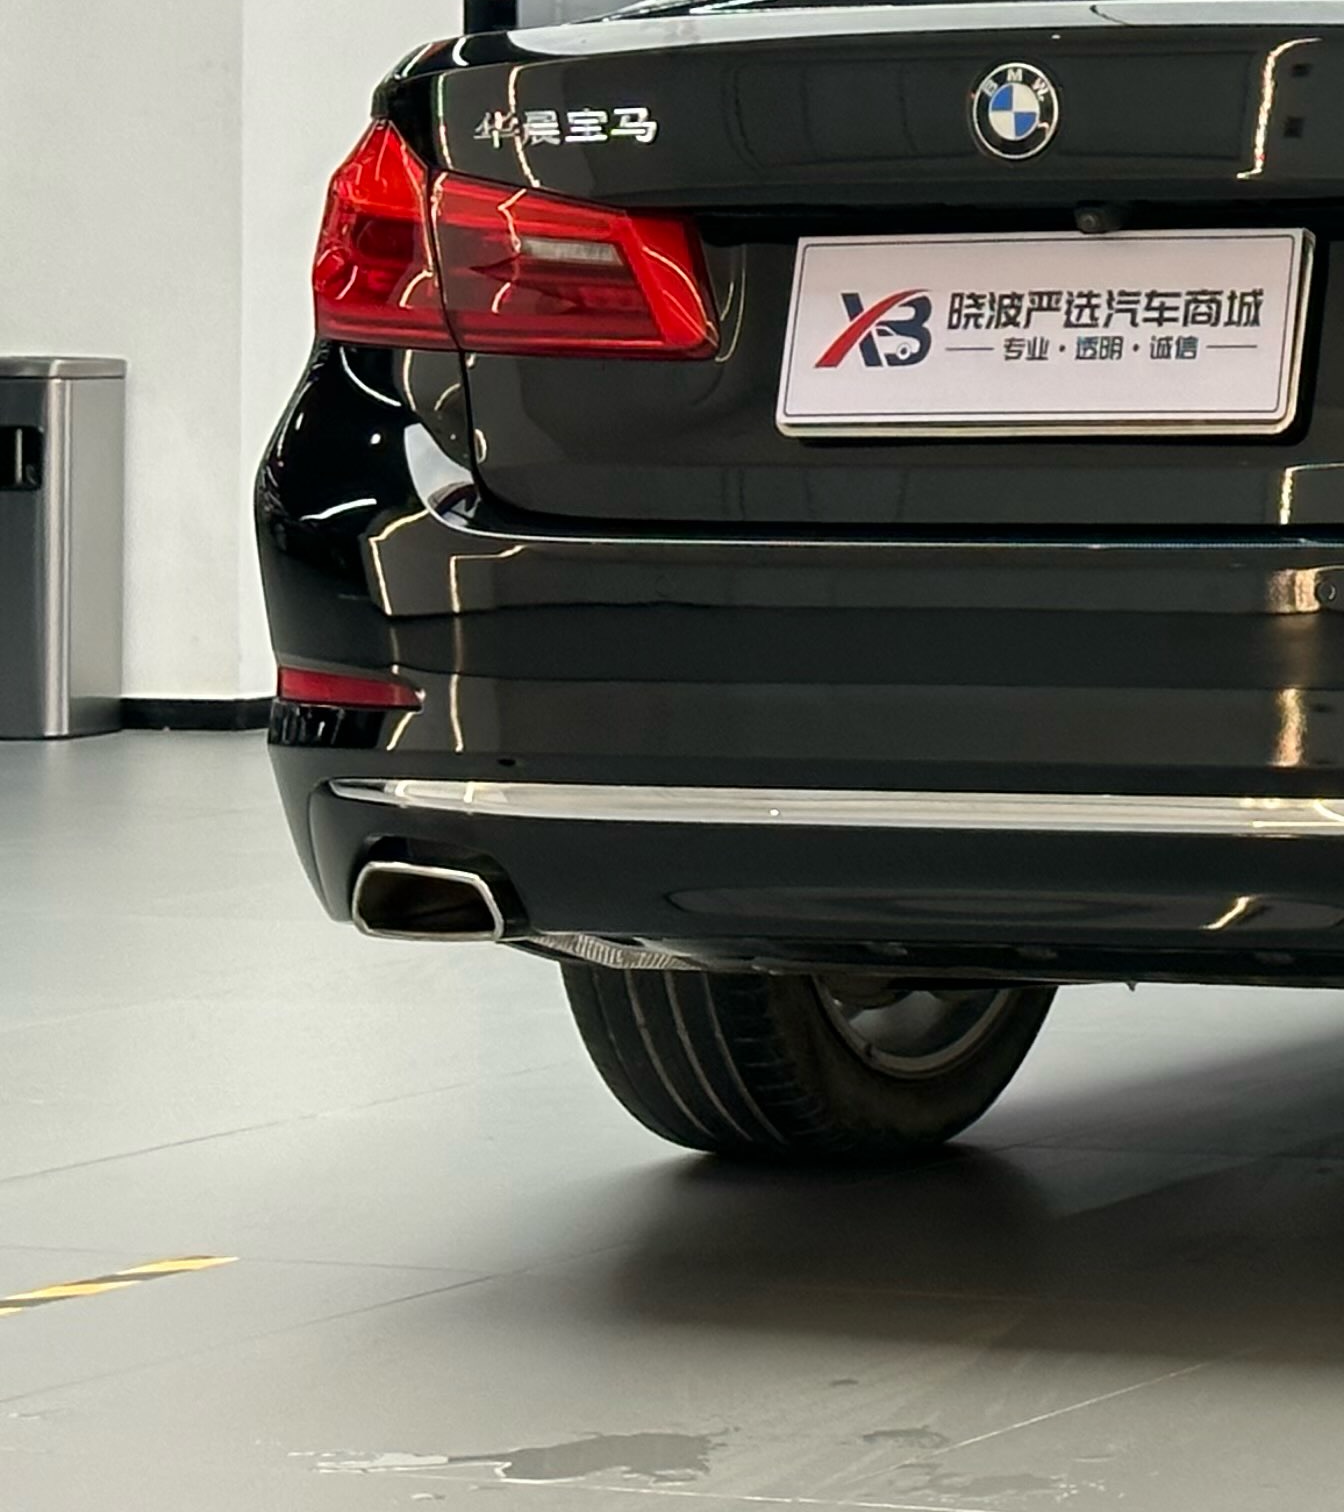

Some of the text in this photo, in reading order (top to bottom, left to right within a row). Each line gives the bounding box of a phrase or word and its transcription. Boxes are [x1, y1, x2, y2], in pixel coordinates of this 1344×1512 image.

[473, 107, 658, 149] 华晨宝马
[947, 288, 1265, 330] 晓波严选汽车商城
